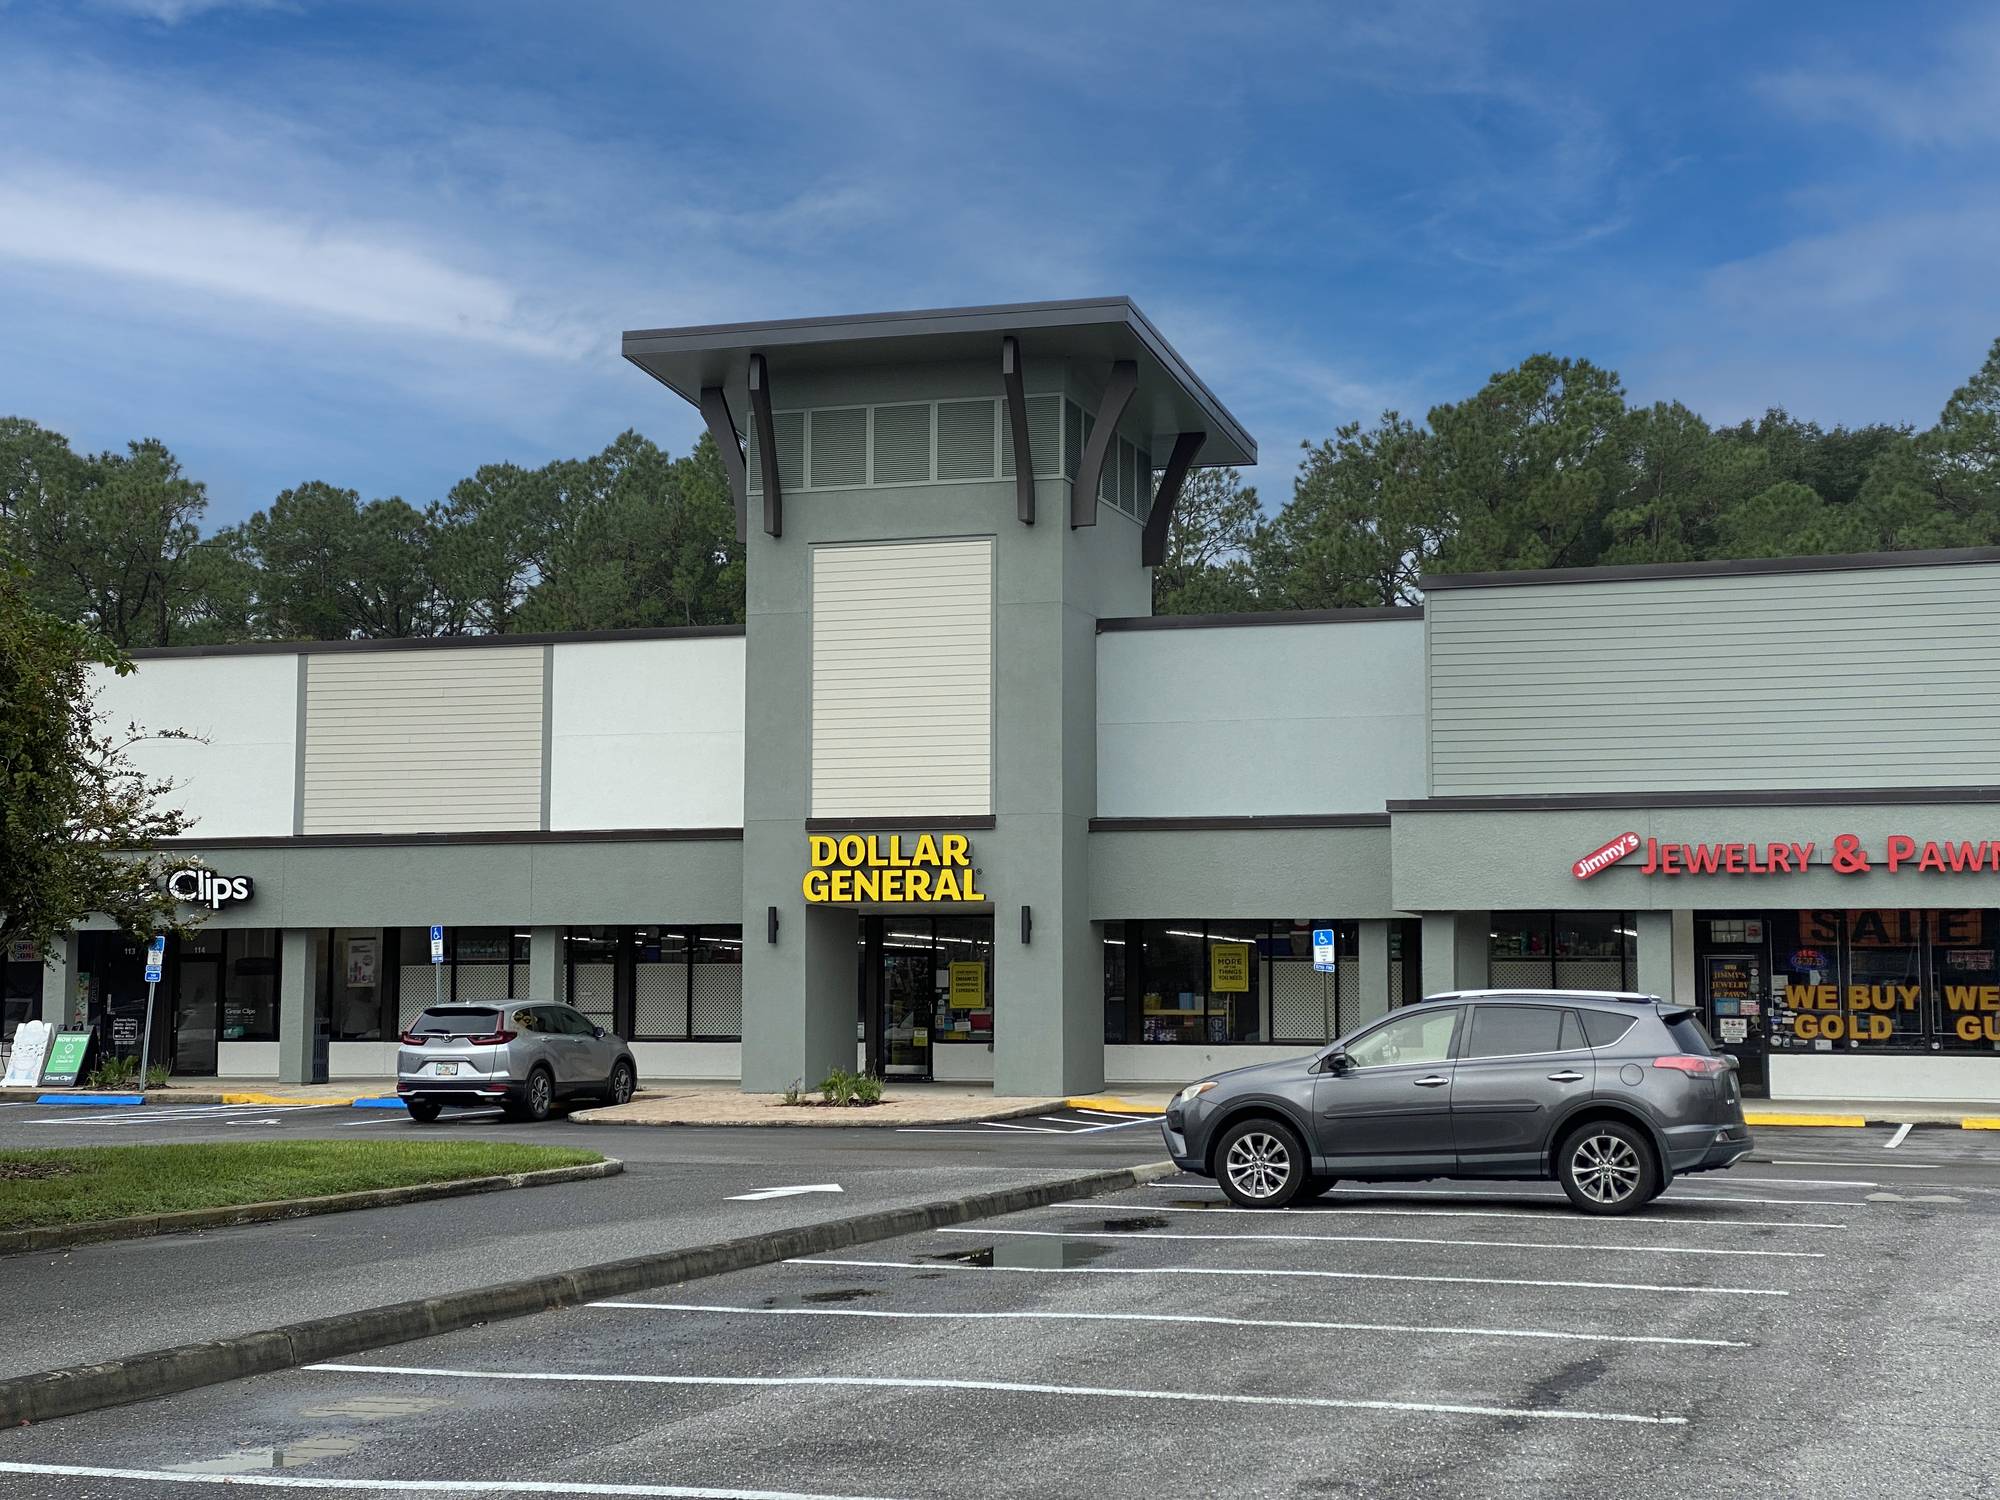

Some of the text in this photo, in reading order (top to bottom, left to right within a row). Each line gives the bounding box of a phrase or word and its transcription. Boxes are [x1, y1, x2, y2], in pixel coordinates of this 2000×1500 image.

[808, 834, 971, 868] DOLLAR
[1577, 833, 1639, 877] Jimmy's
[1831, 834, 1871, 874] &
[168, 869, 249, 909] Clips
[802, 868, 986, 903] GENERAL
[124, 947, 136, 955] 113
[193, 946, 206, 954] 114
[1722, 934, 1737, 943] 117
[1711, 981, 1748, 989] JEWELRY
[1785, 985, 1838, 1009] WE
[1848, 985, 1920, 1010] BUY
[1945, 986, 2000, 1010] WE
[1794, 1014, 1893, 1040] GOLD
